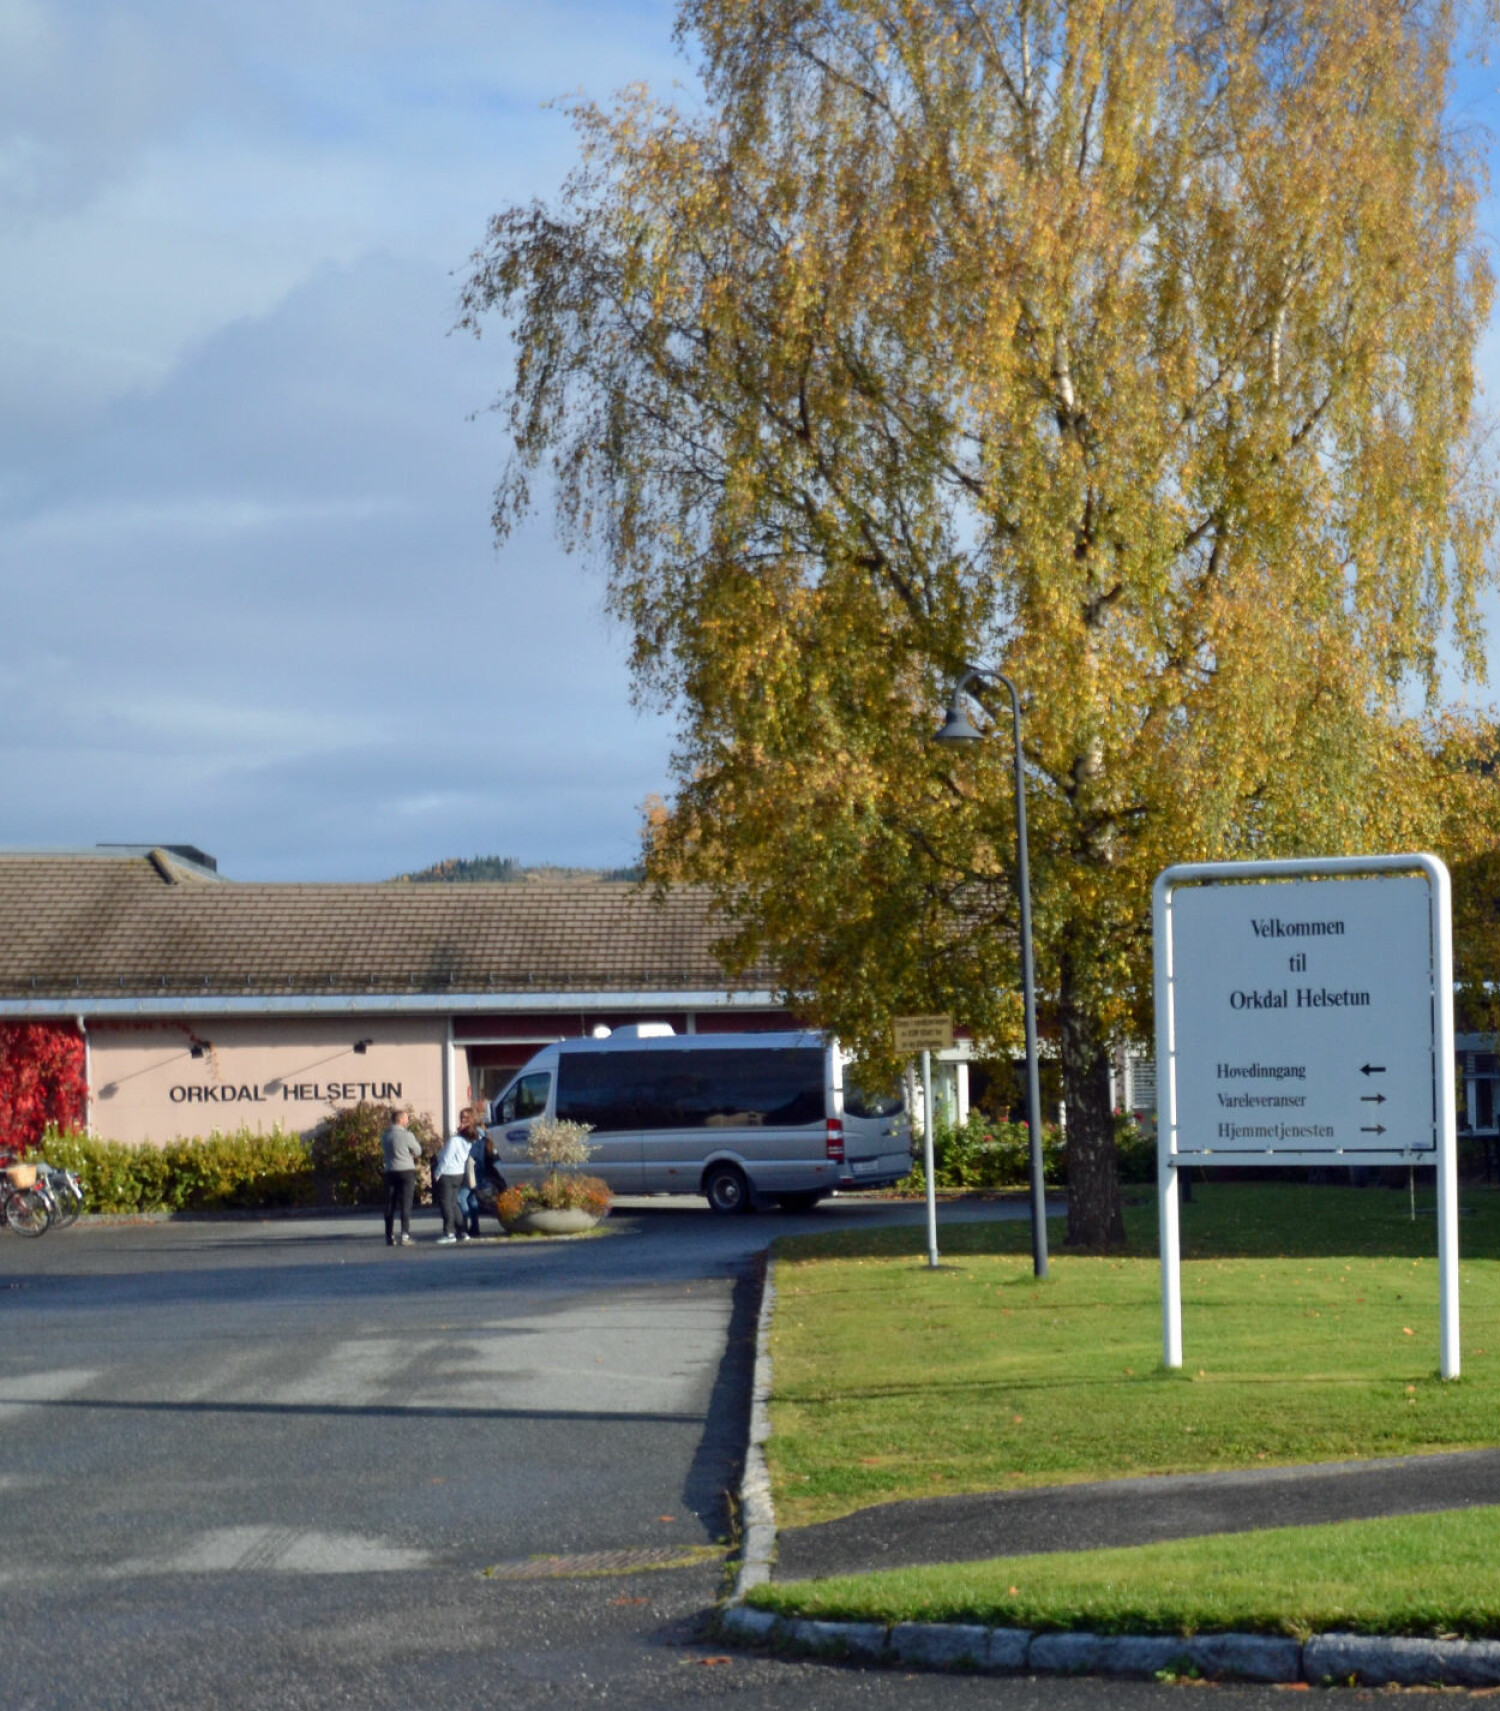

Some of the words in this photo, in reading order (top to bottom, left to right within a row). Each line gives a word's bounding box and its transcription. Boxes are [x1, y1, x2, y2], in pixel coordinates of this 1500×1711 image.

[1250, 919, 1345, 938] Velkommen
[1289, 953, 1307, 972] til
[1230, 989, 1288, 1010] Orkdal
[1296, 988, 1370, 1007] Helsetun
[1216, 1063, 1306, 1080] Hovedinngang
[169, 1084, 267, 1103] ORKDAL
[283, 1082, 402, 1100] HELSETUN
[1217, 1093, 1307, 1108] Vareleveranser
[1218, 1122, 1334, 1141] Hjemmetjenesten
